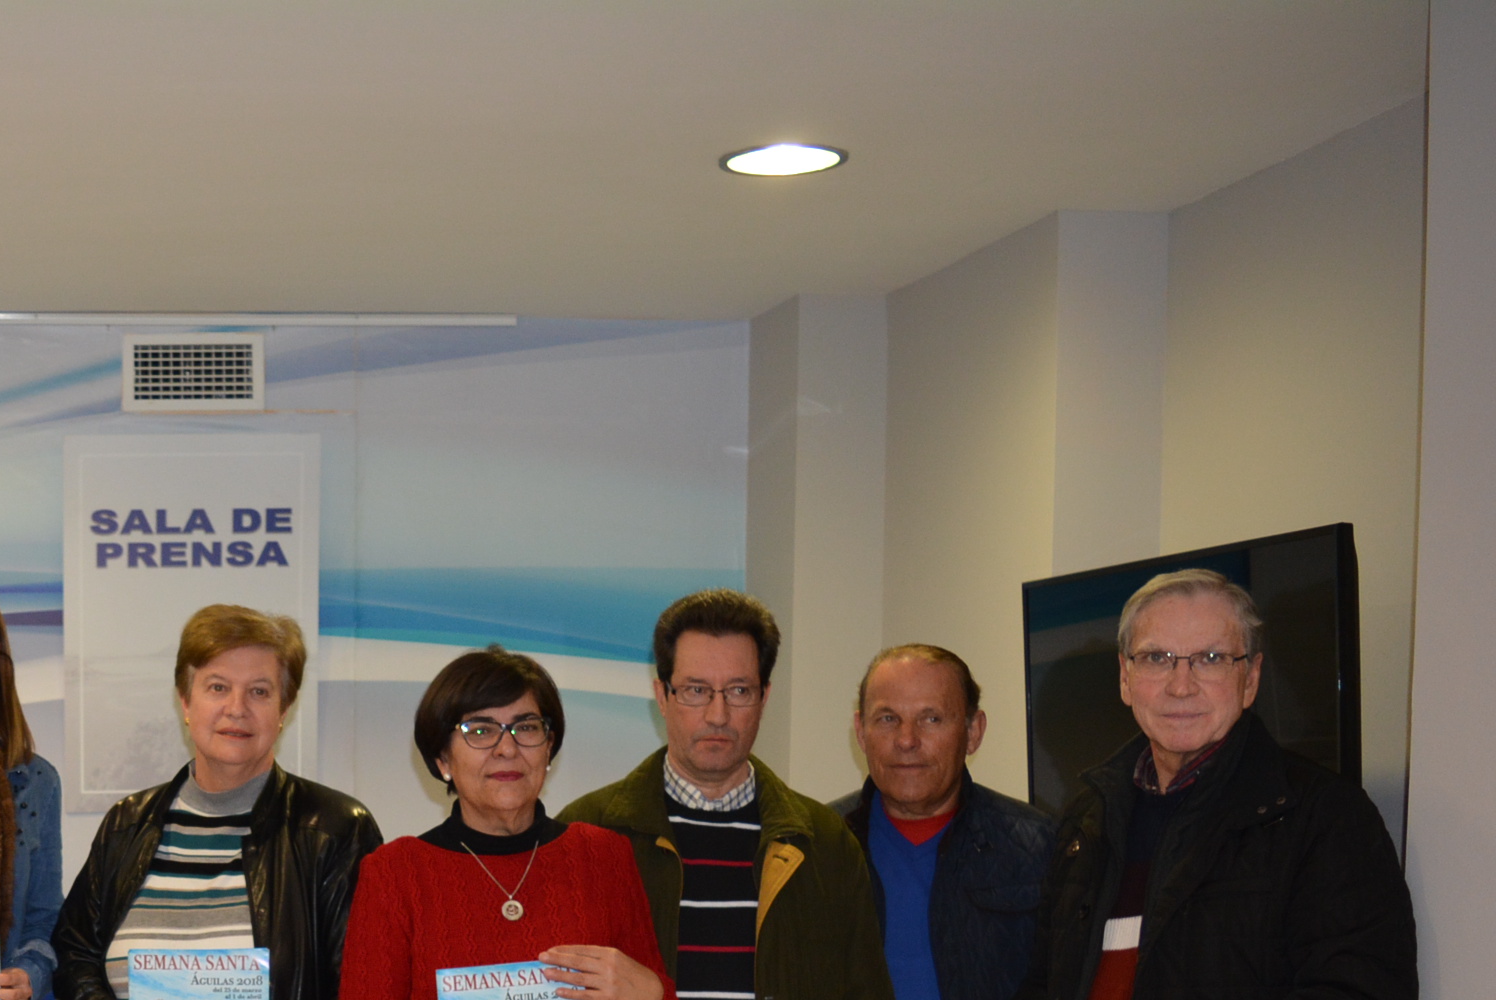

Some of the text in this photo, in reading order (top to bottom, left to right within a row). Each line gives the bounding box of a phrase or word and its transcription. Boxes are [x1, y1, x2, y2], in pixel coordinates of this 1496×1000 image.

[90, 508, 292, 535] SALA DE
[96, 541, 288, 568] PRENSA
[133, 954, 260, 971] SEMANA SANTA
[191, 972, 263, 986] ÁGUILAS 2018
[443, 970, 514, 993] SEMANA
